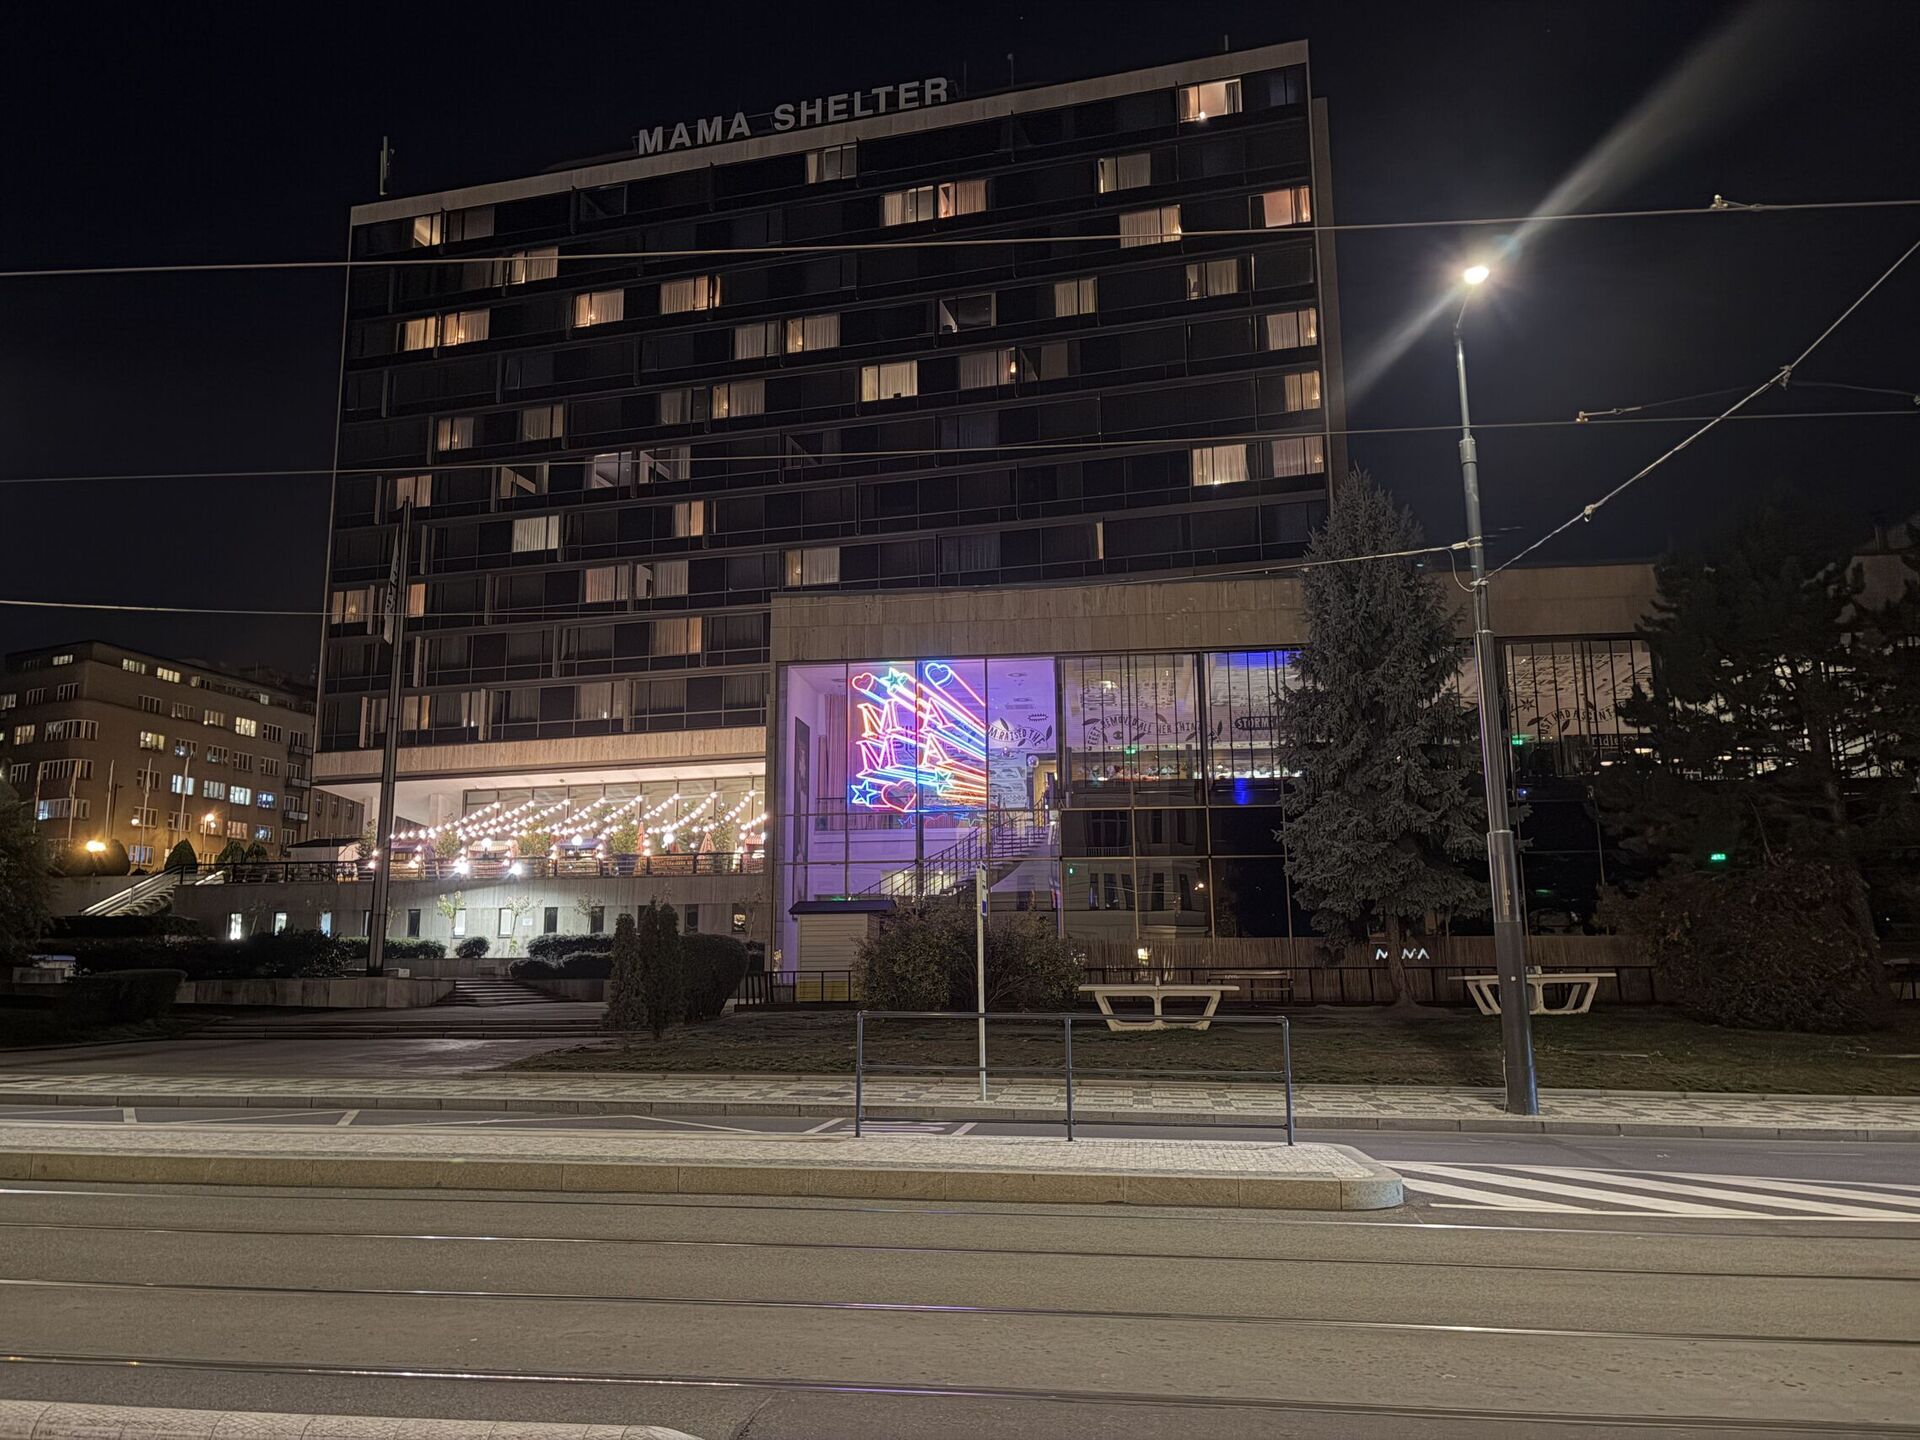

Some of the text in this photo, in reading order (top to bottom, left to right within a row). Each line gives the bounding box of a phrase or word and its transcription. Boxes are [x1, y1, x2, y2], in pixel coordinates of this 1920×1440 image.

[638, 76, 949, 155] MAMA SHELTER
[1028, 729, 1046, 747] THE
